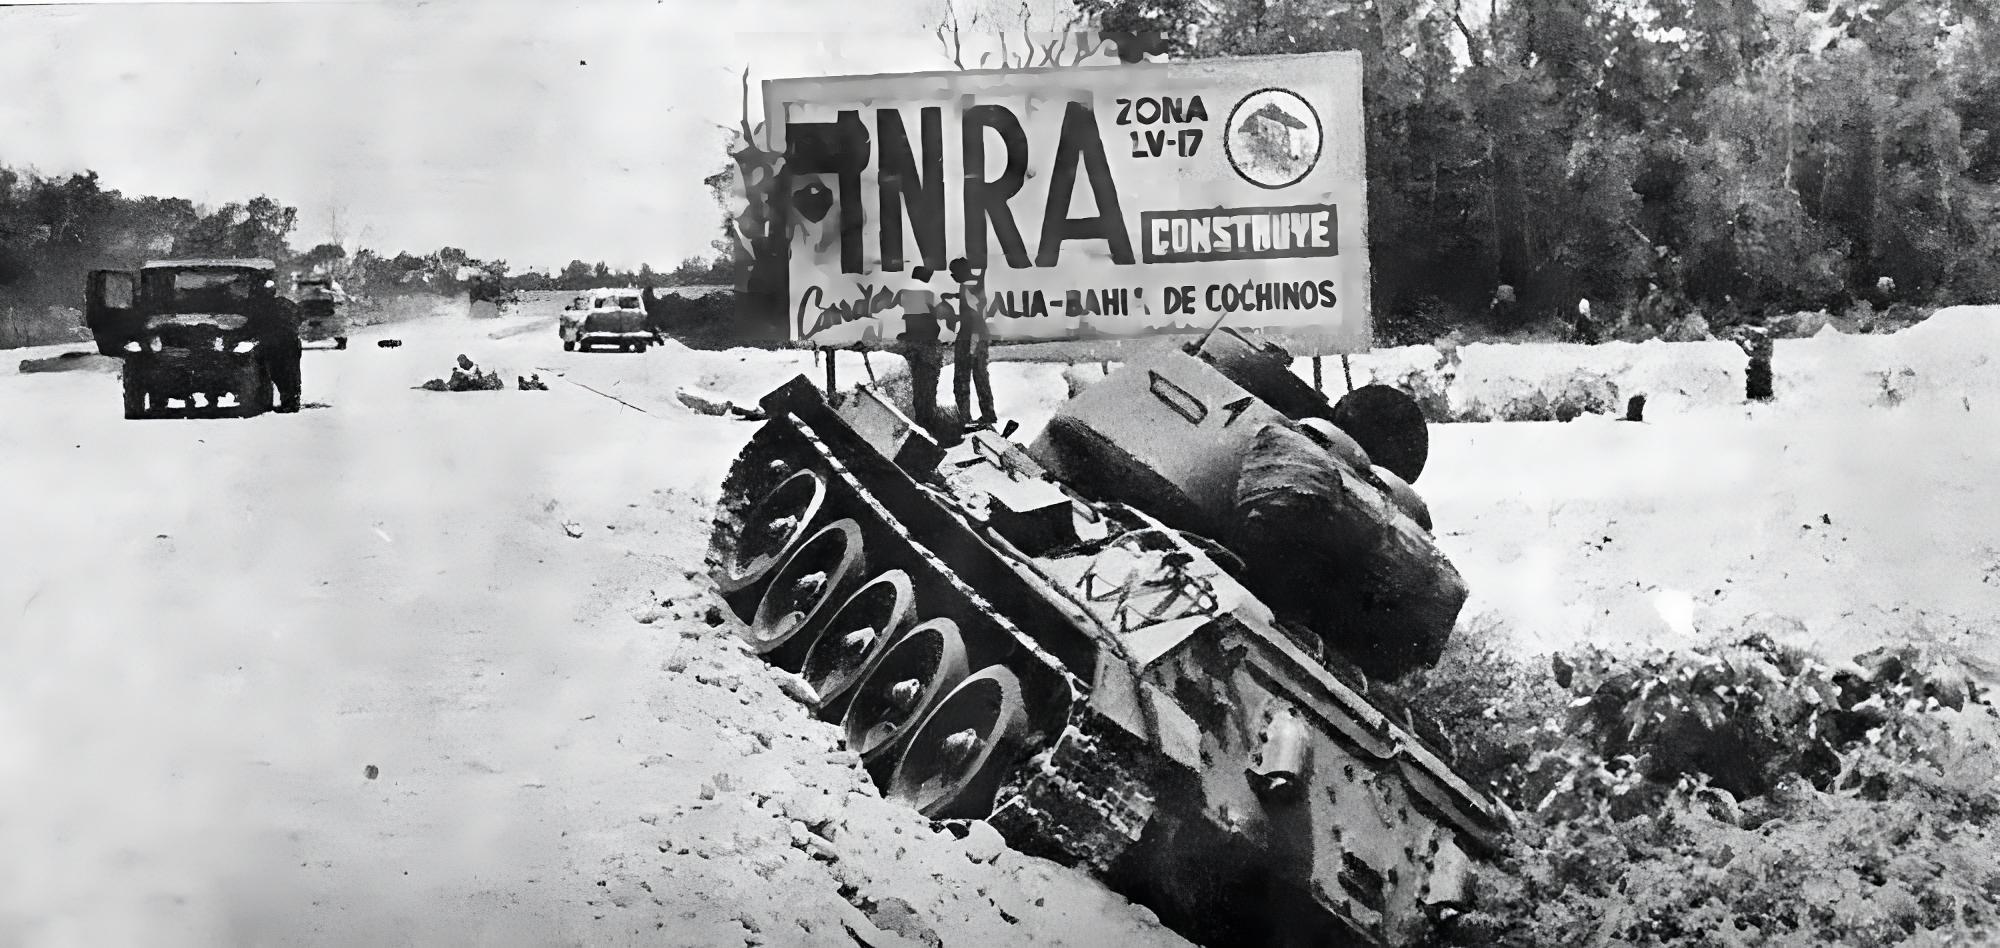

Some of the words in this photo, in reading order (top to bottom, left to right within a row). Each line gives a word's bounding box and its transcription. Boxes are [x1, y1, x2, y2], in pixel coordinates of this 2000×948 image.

[1116, 95, 1209, 125] ZONA
[1129, 128, 1204, 158] LV-17
[1151, 211, 1330, 256] CONSTRUYE
[1163, 285, 1196, 315] DE
[1205, 279, 1337, 312] COCHINOS
